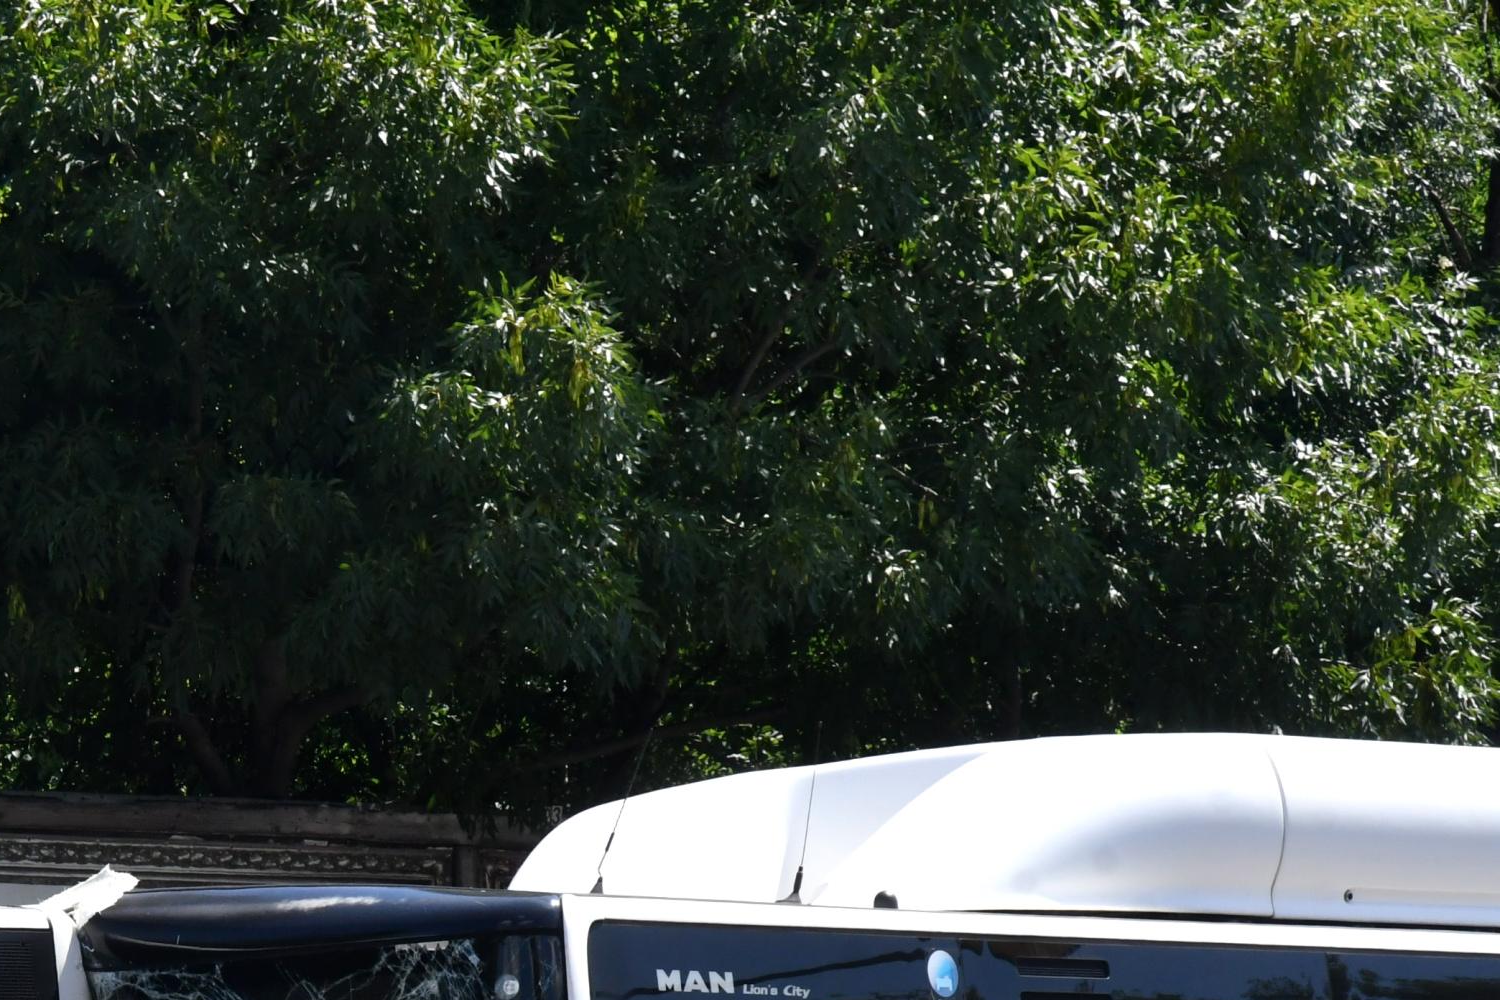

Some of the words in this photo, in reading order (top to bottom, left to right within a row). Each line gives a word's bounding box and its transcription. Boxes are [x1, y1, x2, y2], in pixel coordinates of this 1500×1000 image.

[656, 969, 735, 994] MAN
[743, 984, 779, 996] Lion's
[783, 984, 812, 999] City
